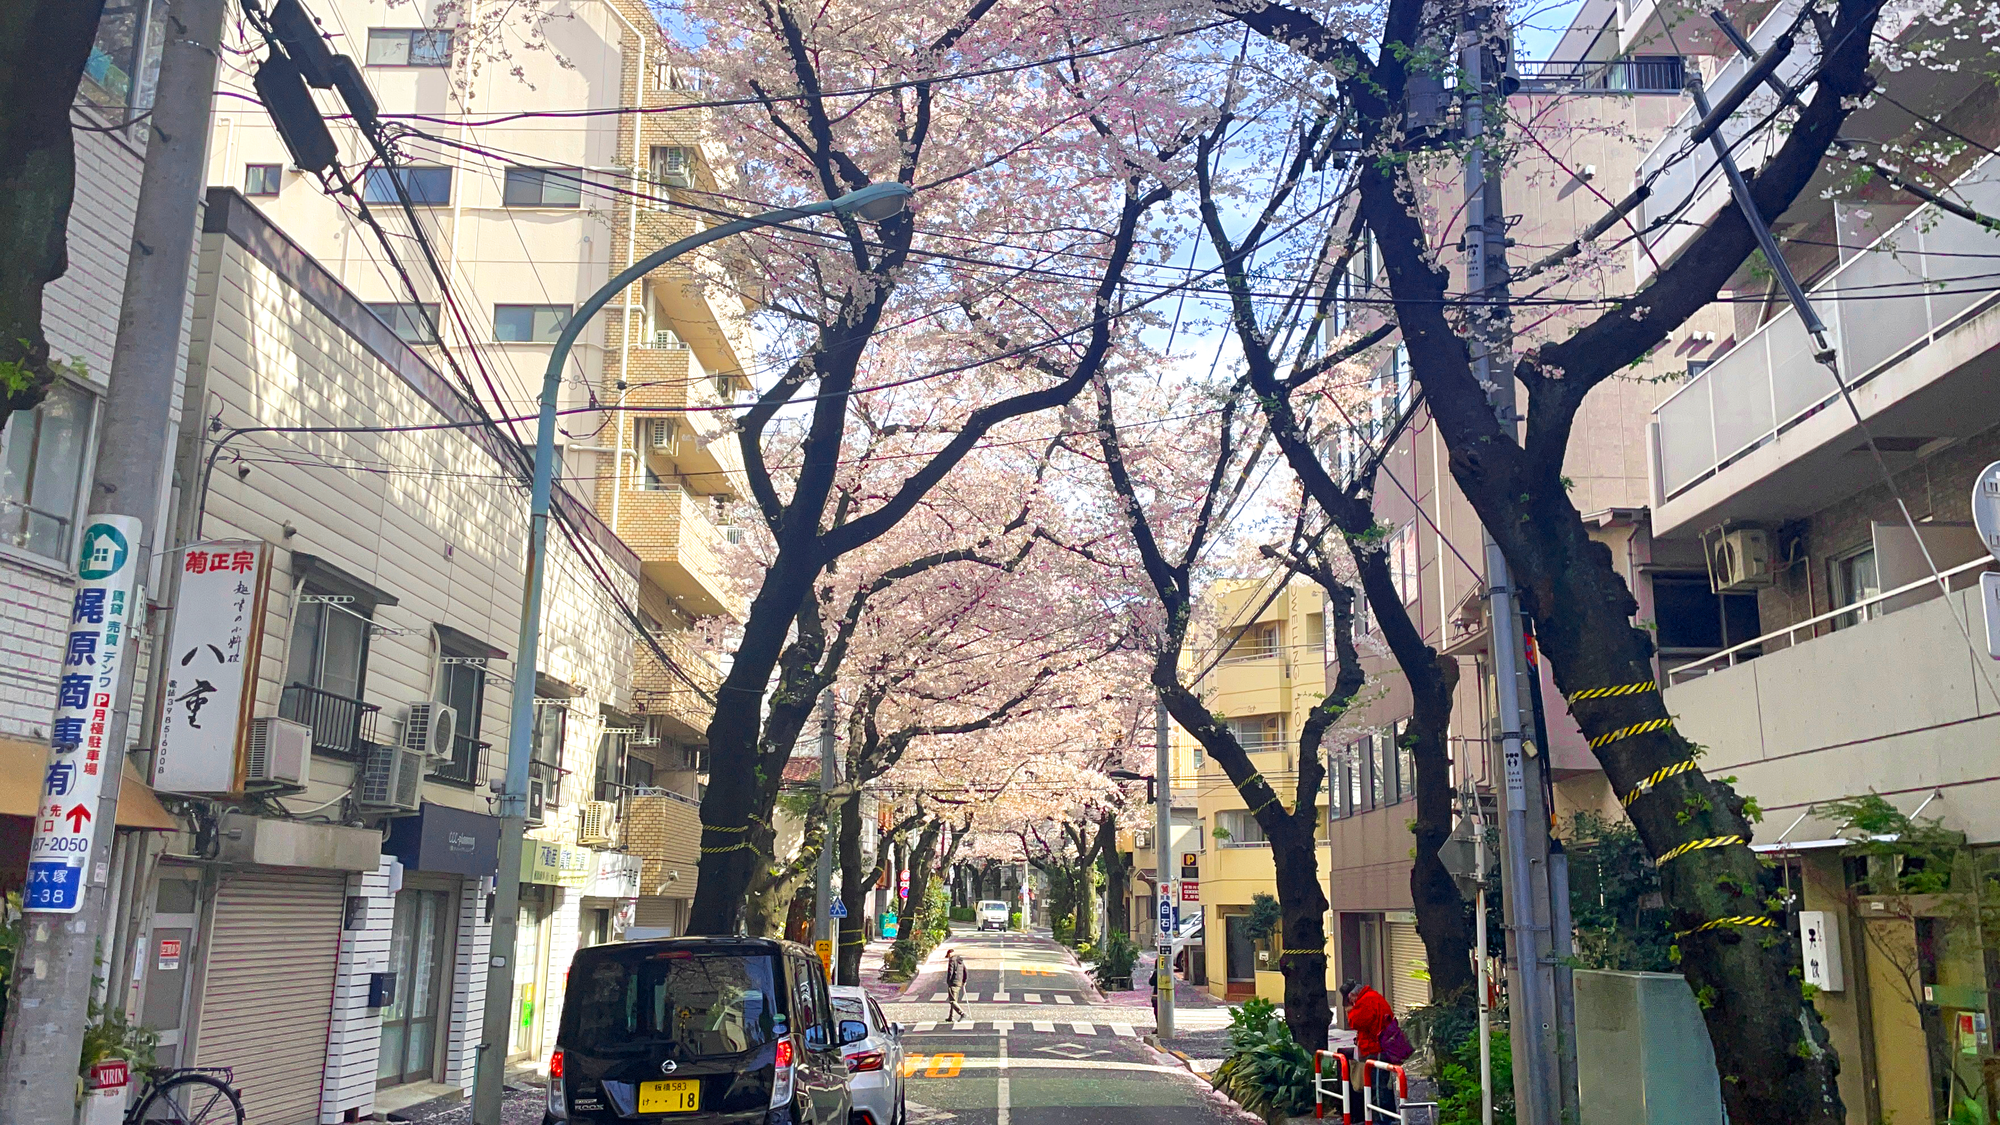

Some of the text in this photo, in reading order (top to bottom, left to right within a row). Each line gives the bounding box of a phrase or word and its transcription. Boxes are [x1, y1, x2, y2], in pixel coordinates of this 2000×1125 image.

[186, 551, 254, 574] 菊正宗
[105, 621, 121, 646] 売買
[83, 709, 106, 776] 月極駐車場
[101, 1068, 124, 1085] KIRIN
